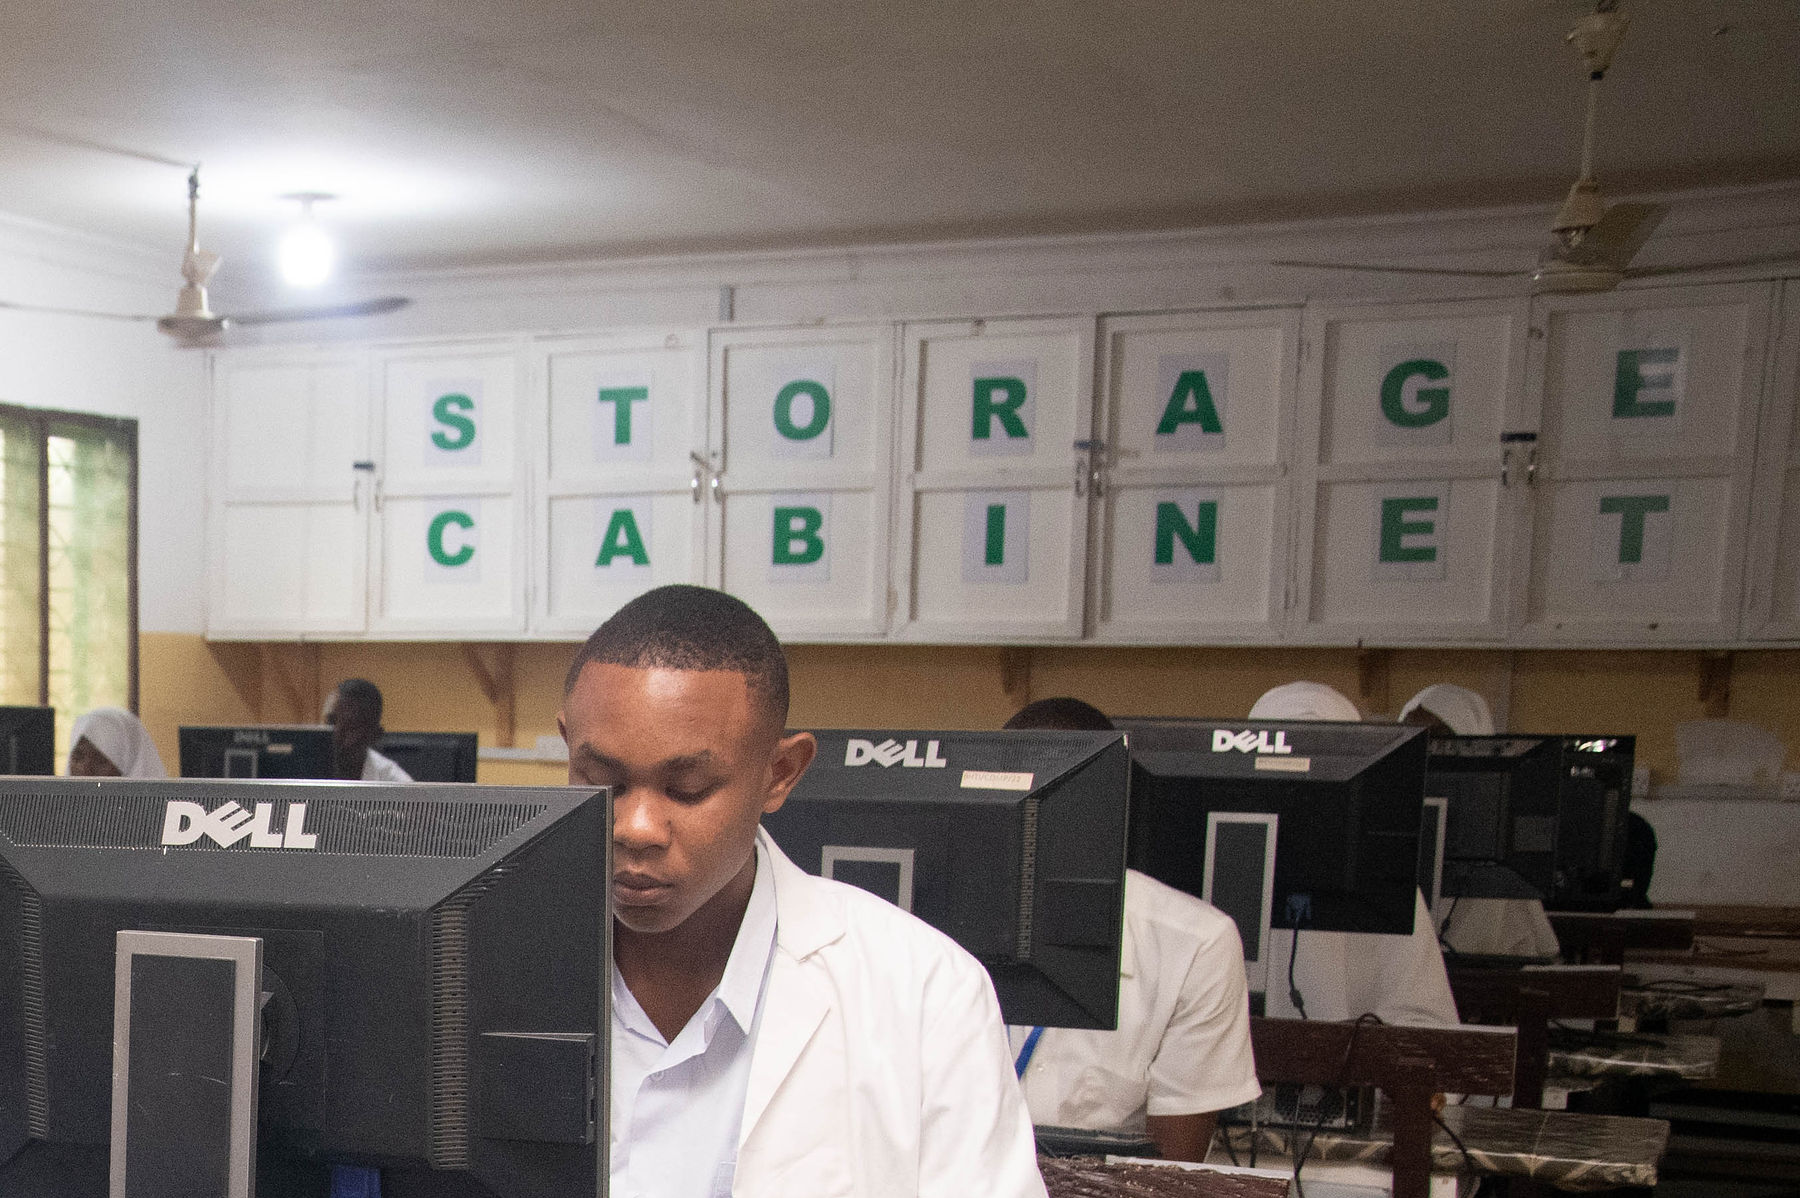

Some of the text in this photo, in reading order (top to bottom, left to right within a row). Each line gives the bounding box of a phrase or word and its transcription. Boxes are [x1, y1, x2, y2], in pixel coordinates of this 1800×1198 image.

[429, 347, 1680, 452] STORAGE
[426, 495, 1671, 569] CABINET
[844, 738, 947, 768] DELL
[1212, 729, 1292, 754] DELL
[161, 800, 317, 849] DELL
